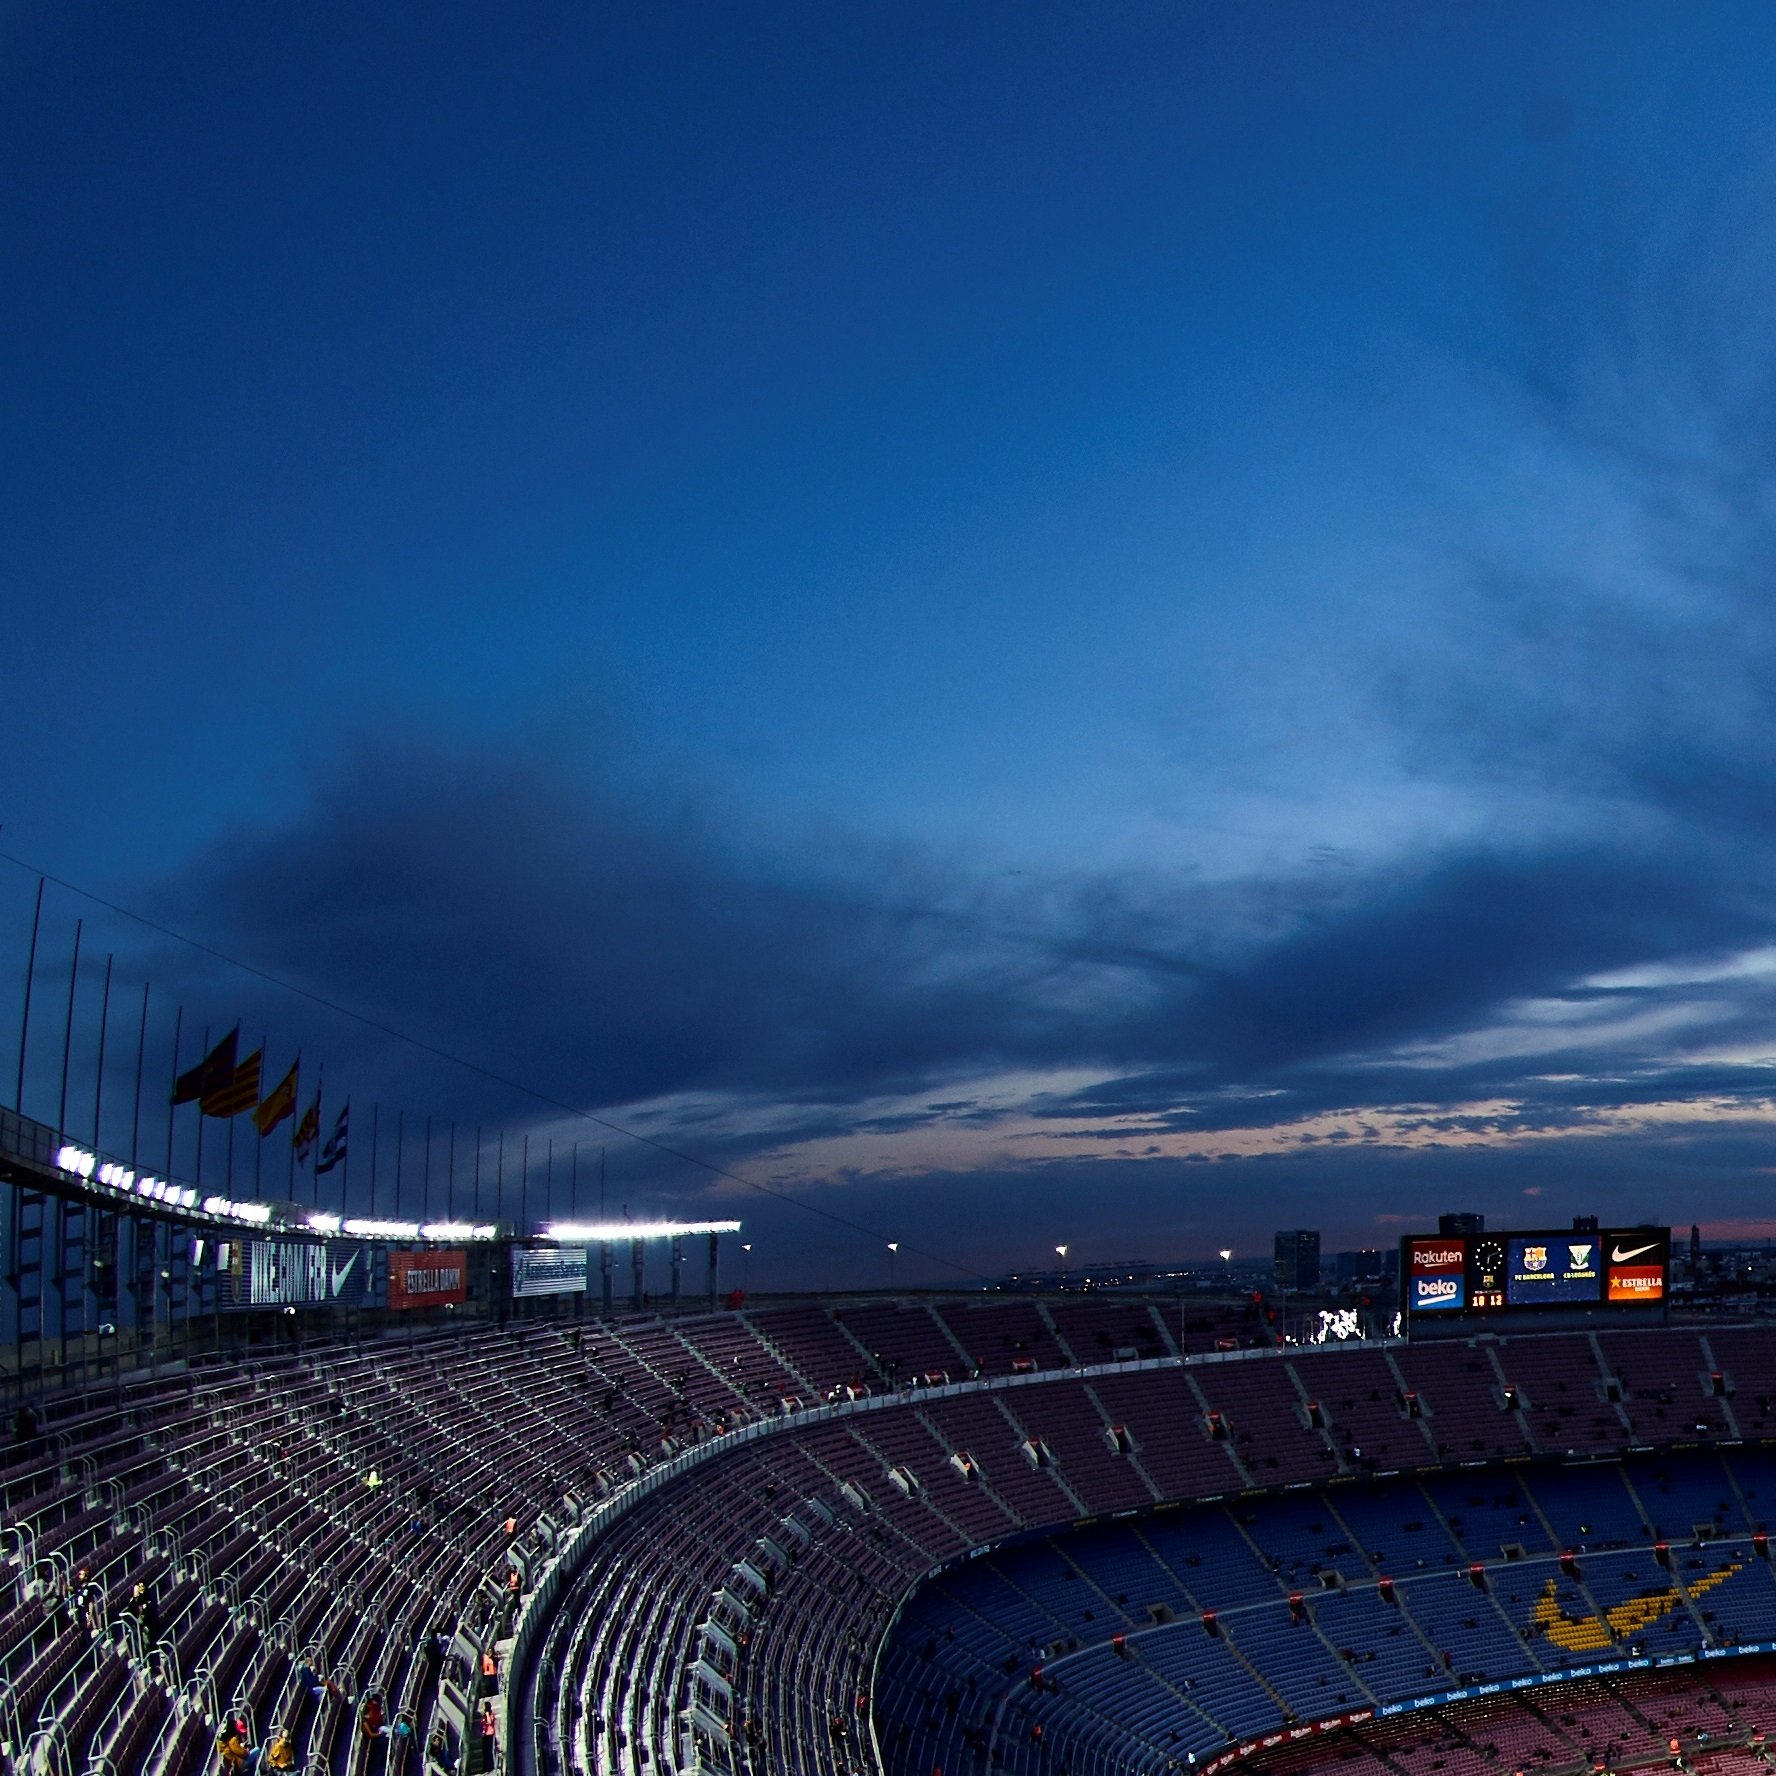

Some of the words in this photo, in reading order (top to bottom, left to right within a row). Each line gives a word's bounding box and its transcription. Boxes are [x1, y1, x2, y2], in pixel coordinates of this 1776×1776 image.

[1414, 1250, 1462, 1264] Rakuten
[407, 1269, 438, 1294] ESTRELLA
[1418, 1279, 1457, 1296] beko
[1622, 1278, 1662, 1288] ESTRELLA
[1705, 1649, 1726, 1658] beko
[1738, 1646, 1759, 1654] beko
[1383, 1706, 1402, 1715] beko
[1414, 1697, 1434, 1707] beko
[1447, 1691, 1467, 1700] beko
[1479, 1684, 1499, 1694] beko
[1512, 1678, 1532, 1688] beko
[1542, 1673, 1562, 1682] beko
[1571, 1668, 1591, 1677] beko
[1599, 1663, 1619, 1672] beko
[1628, 1659, 1648, 1668] beko
